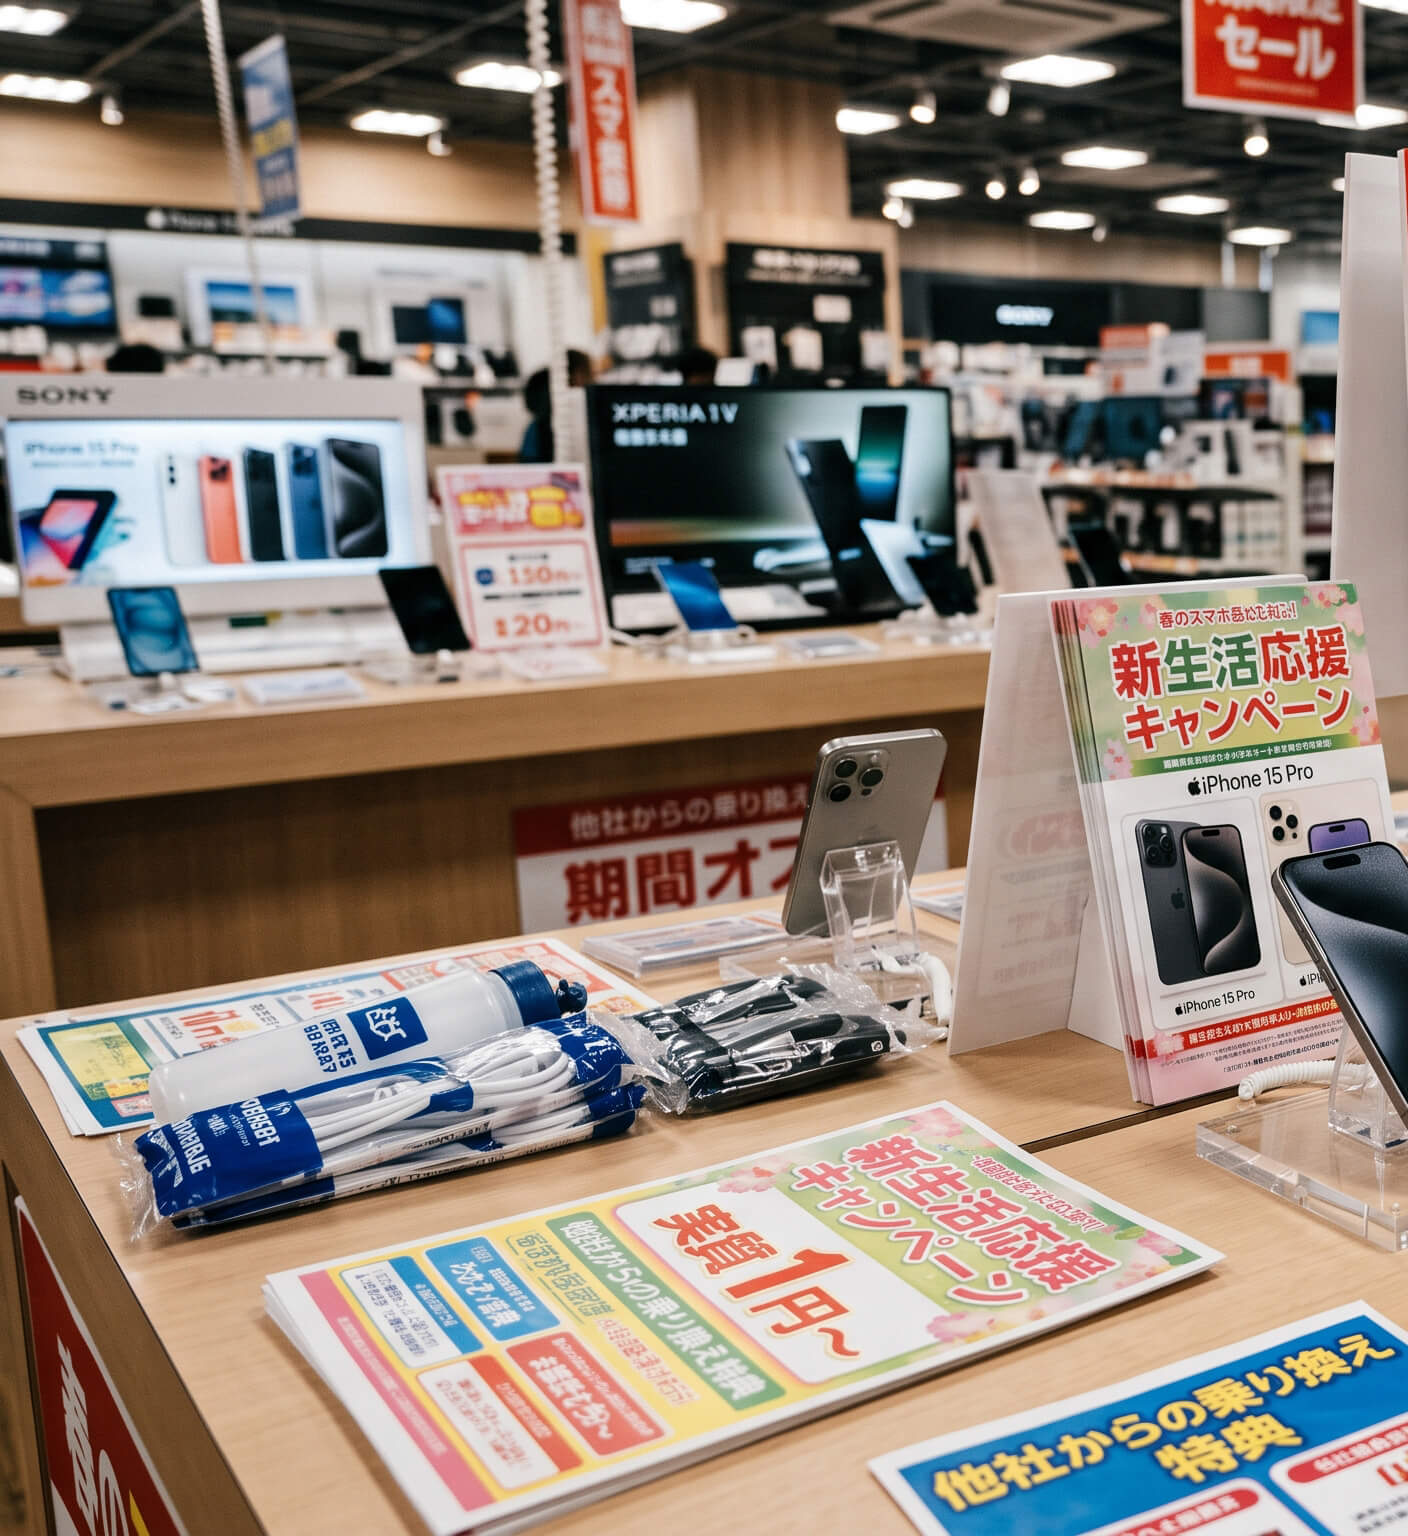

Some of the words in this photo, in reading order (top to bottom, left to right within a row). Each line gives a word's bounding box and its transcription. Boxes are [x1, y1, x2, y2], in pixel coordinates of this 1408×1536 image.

[1215, 14, 1336, 80] セール
[16, 387, 114, 405] SONY
[612, 403, 706, 424] XPERIA
[1110, 625, 1352, 700] 新生活応援
[1124, 689, 1351, 751] キャンペーン
[1202, 774, 1262, 797] iPhone
[1263, 768, 1283, 787] 15
[1286, 763, 1314, 784] Pro
[1183, 997, 1221, 1015] iPhone
[1222, 992, 1235, 1004] 15
[1237, 989, 1256, 1002] Pro
[792, 1162, 1025, 1303] キャンペーン
[843, 1135, 1120, 1292] 新生活応援
[933, 1332, 1396, 1512] 他社からの乗り換え
[1155, 1411, 1303, 1483] 特典
